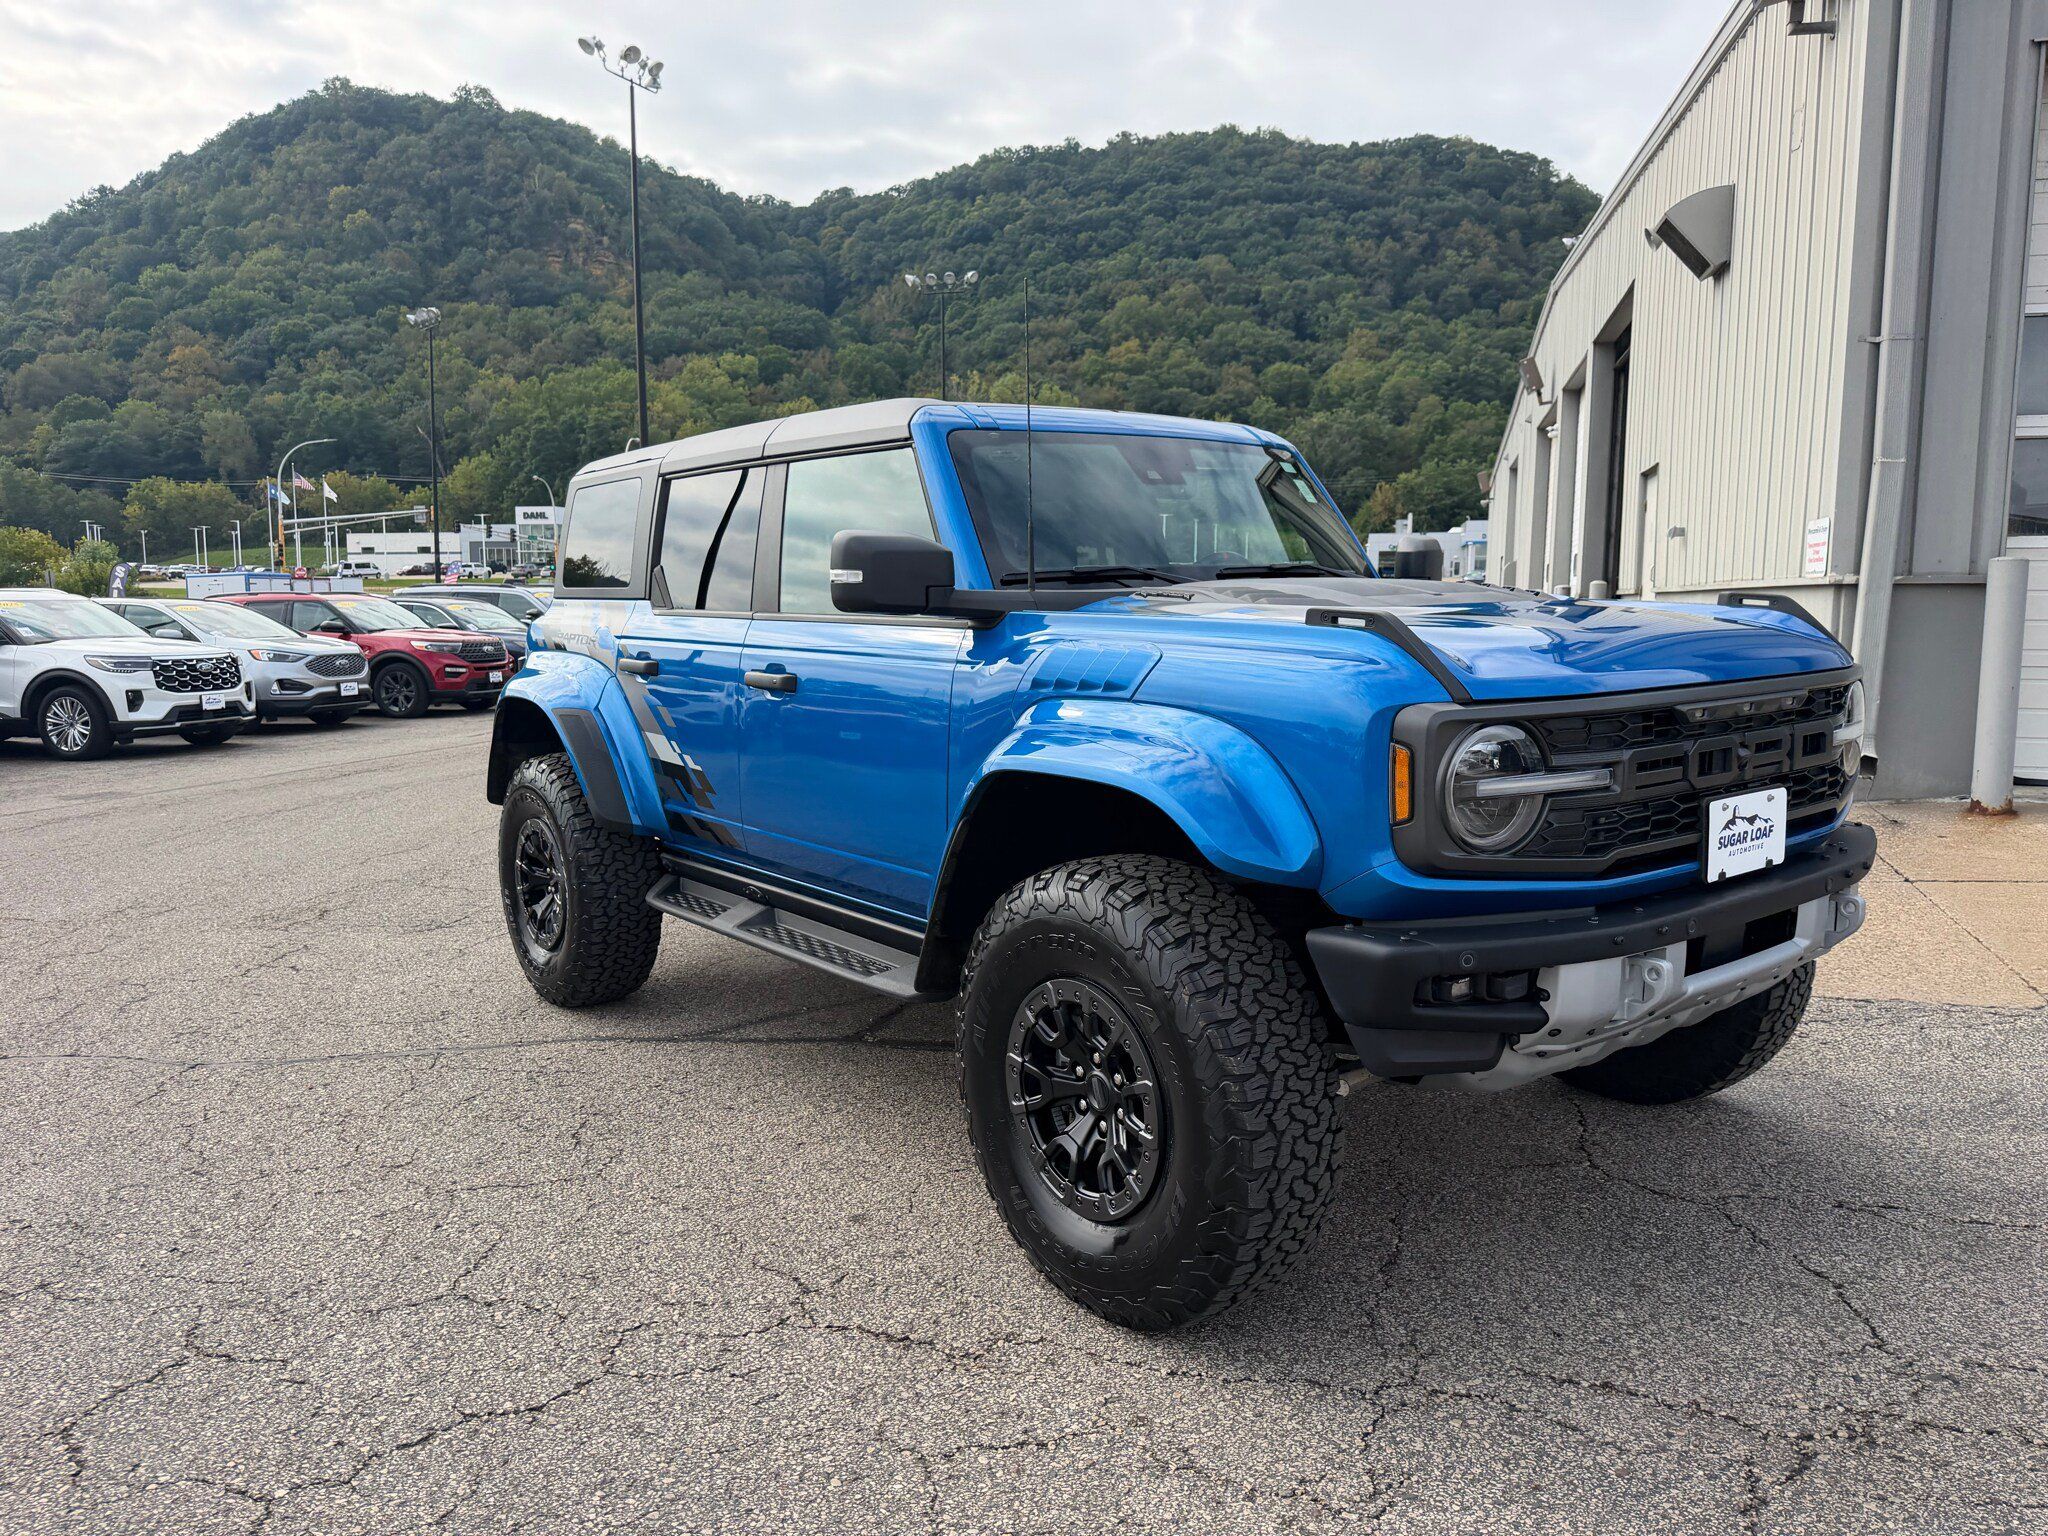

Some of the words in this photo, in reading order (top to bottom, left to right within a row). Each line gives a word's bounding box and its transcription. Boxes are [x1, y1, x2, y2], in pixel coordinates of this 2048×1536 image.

[557, 632, 597, 646] RAPTOR
[1628, 719, 1834, 791] FORD
[1717, 830, 1748, 851] SUGAR
[1750, 825, 1775, 843] LOAF
[1728, 842, 1764, 857] AUTOMOTIVE
